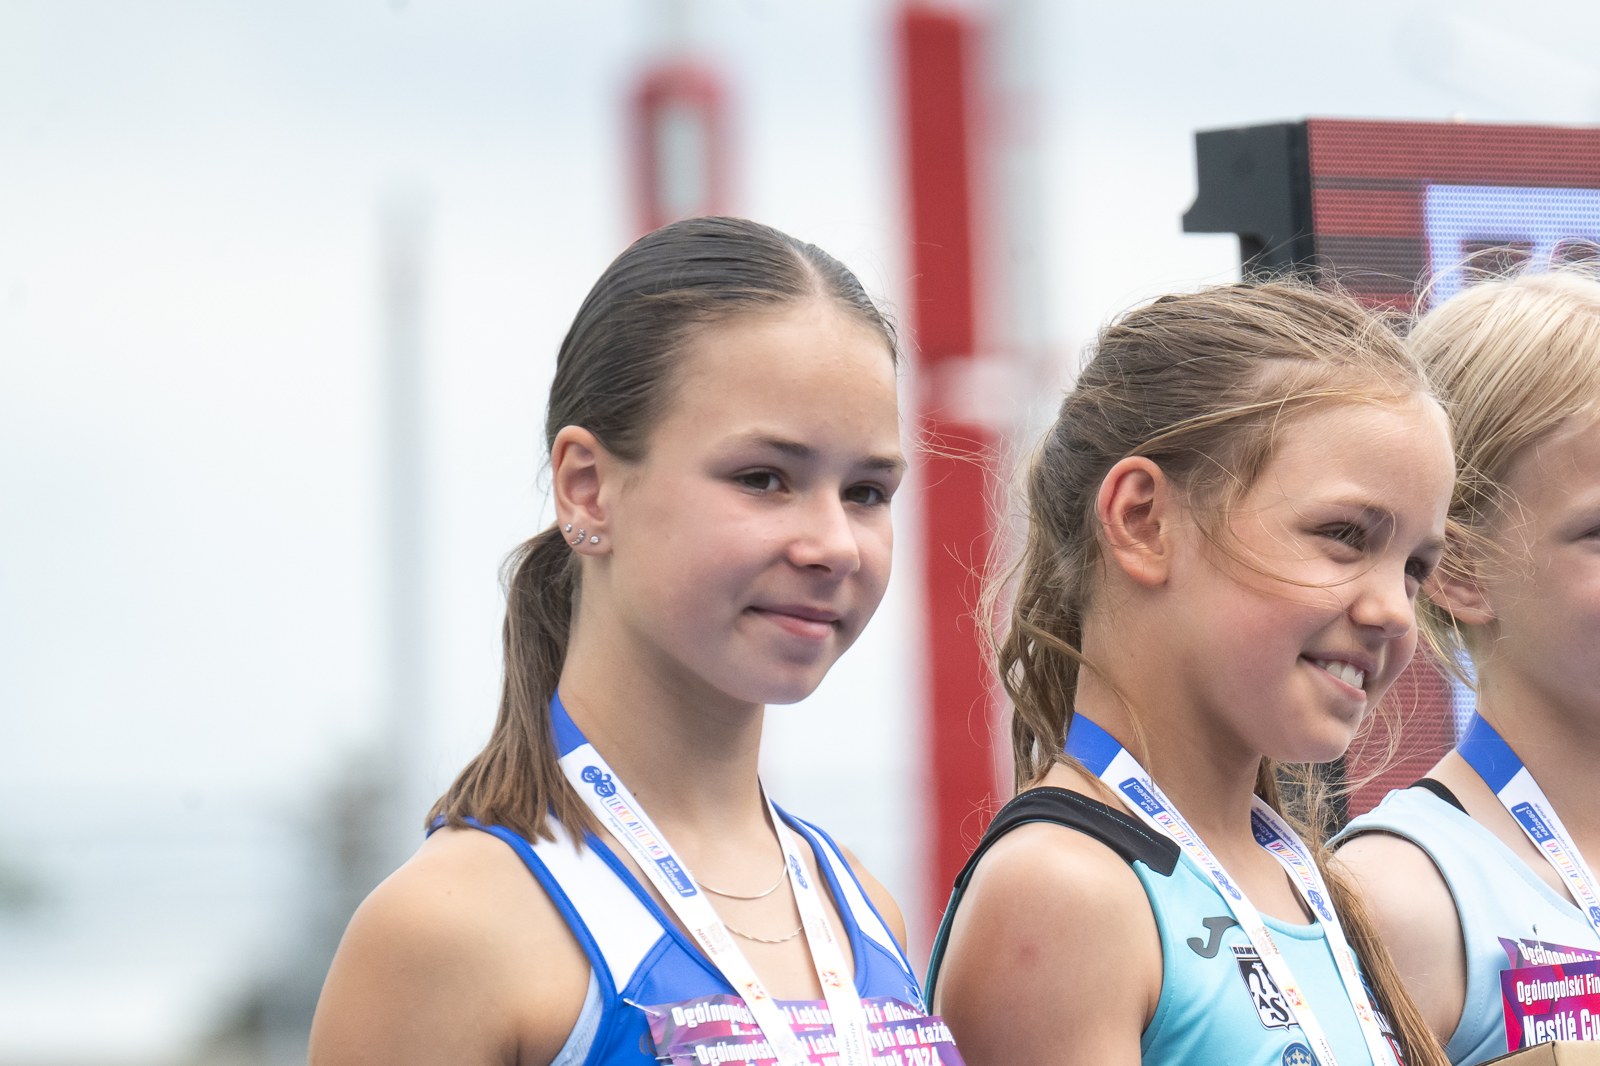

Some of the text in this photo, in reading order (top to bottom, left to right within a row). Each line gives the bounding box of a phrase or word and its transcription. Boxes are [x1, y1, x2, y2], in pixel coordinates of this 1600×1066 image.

[606, 798, 663, 856] LEKKOATLETYKA
[1158, 815, 1216, 869] LEKKOATLETYKA
[1531, 827, 1543, 839] DLA
[667, 860, 680, 873] DLA
[1546, 843, 1596, 904] LEKKOATLETYKA
[1516, 977, 1585, 1005] Ogólnopolski
[671, 1002, 757, 1028] Ogólnopolsk
[695, 1025, 917, 1066] Ogólnopolsk dla
